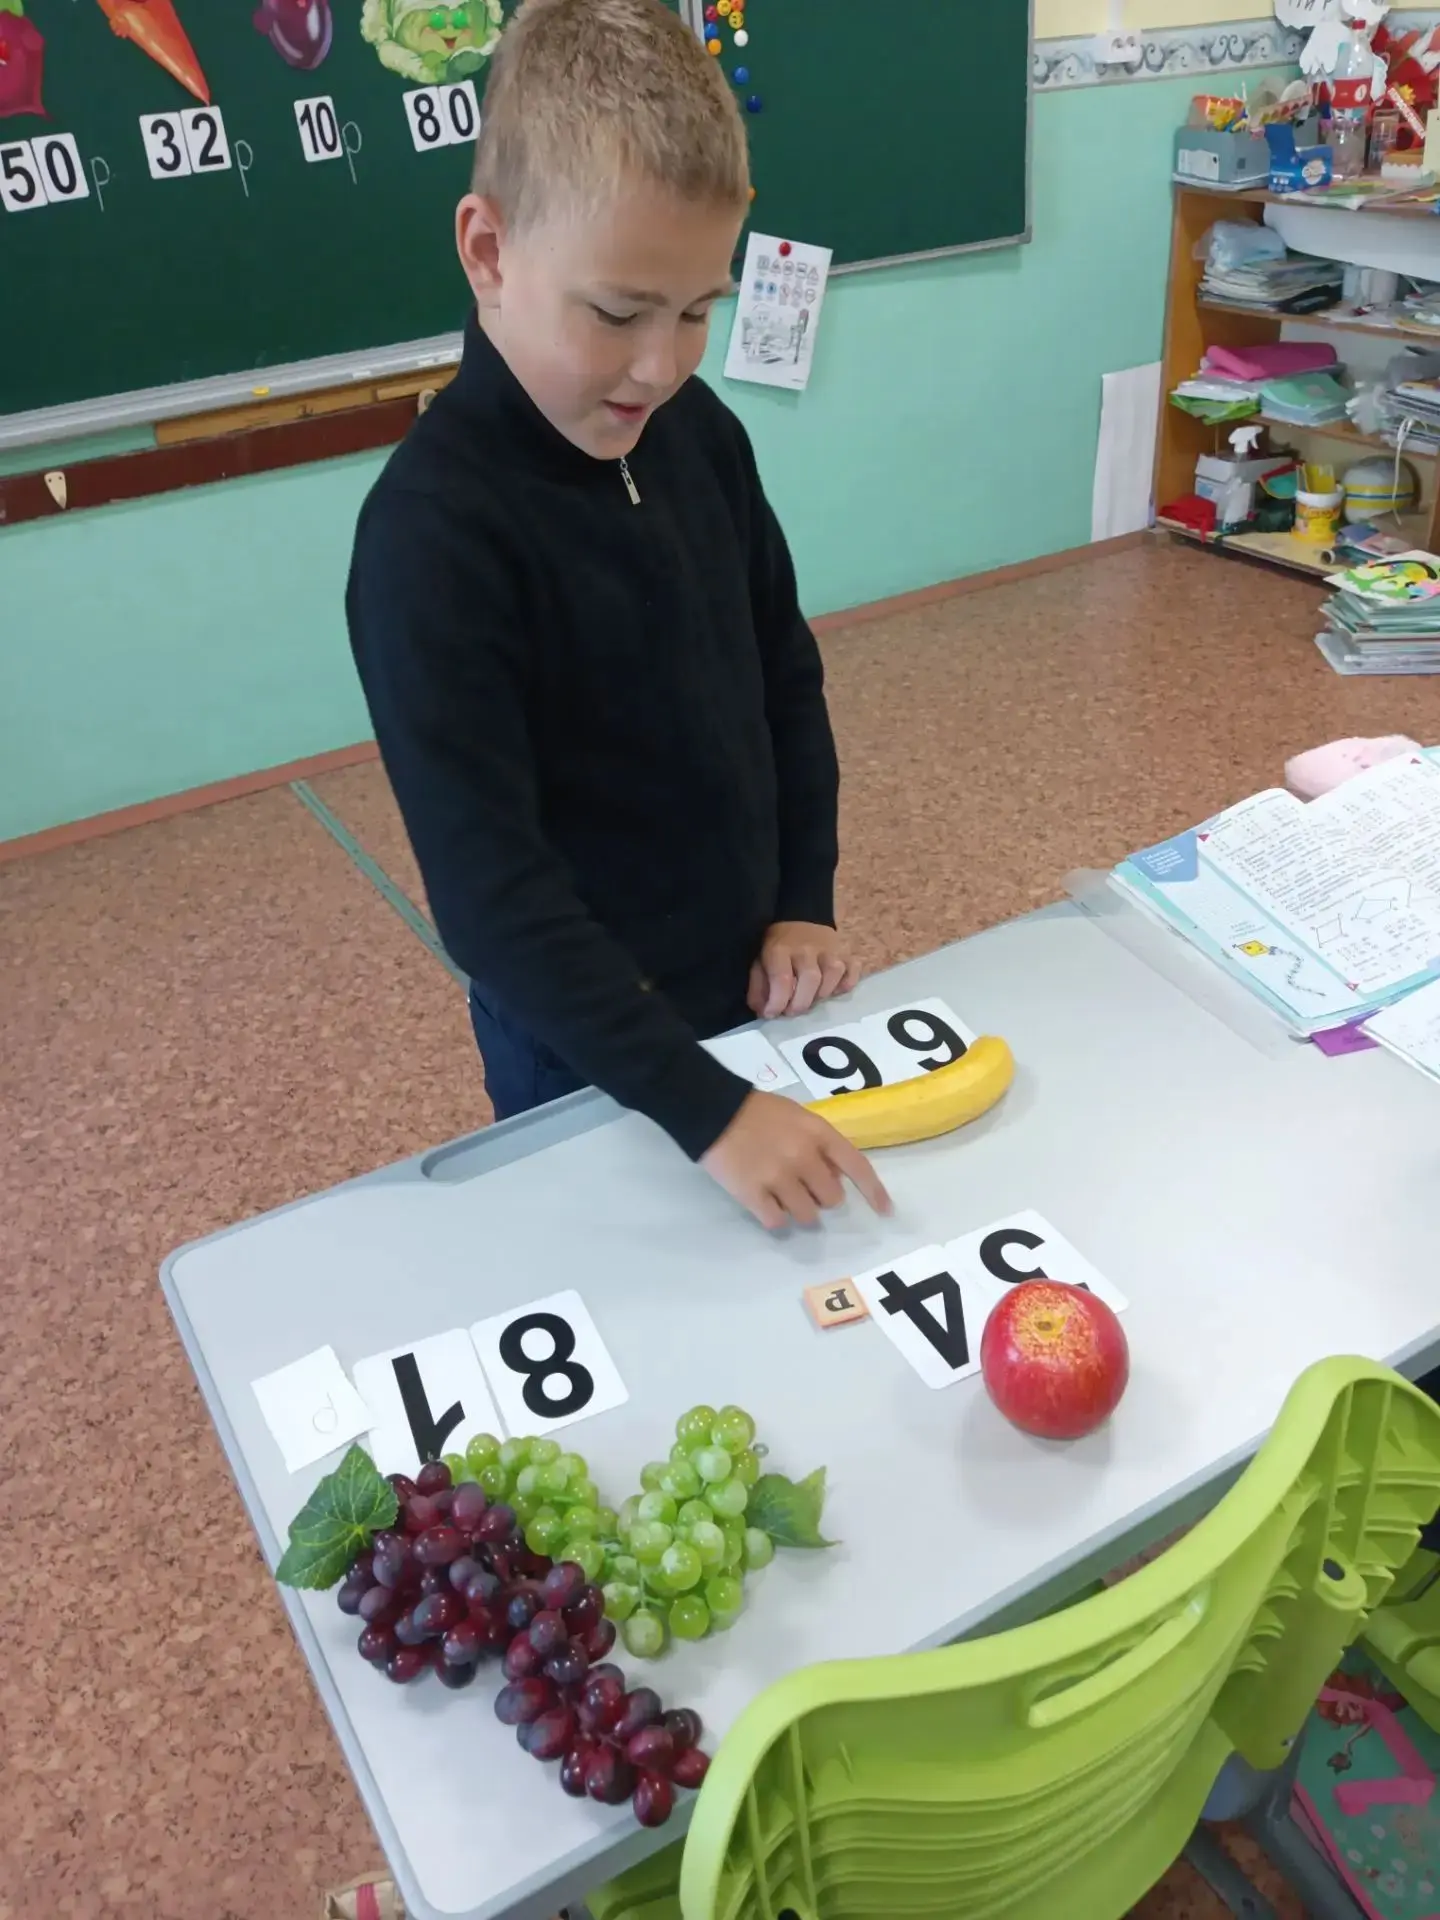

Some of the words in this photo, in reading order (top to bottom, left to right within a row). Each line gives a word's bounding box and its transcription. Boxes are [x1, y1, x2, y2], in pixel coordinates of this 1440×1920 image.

[151, 113, 225, 172] 32
[300, 102, 338, 154] 10
[413, 88, 474, 142] 80
[0, 141, 77, 203] 50
[391, 1312, 594, 1466] 81
